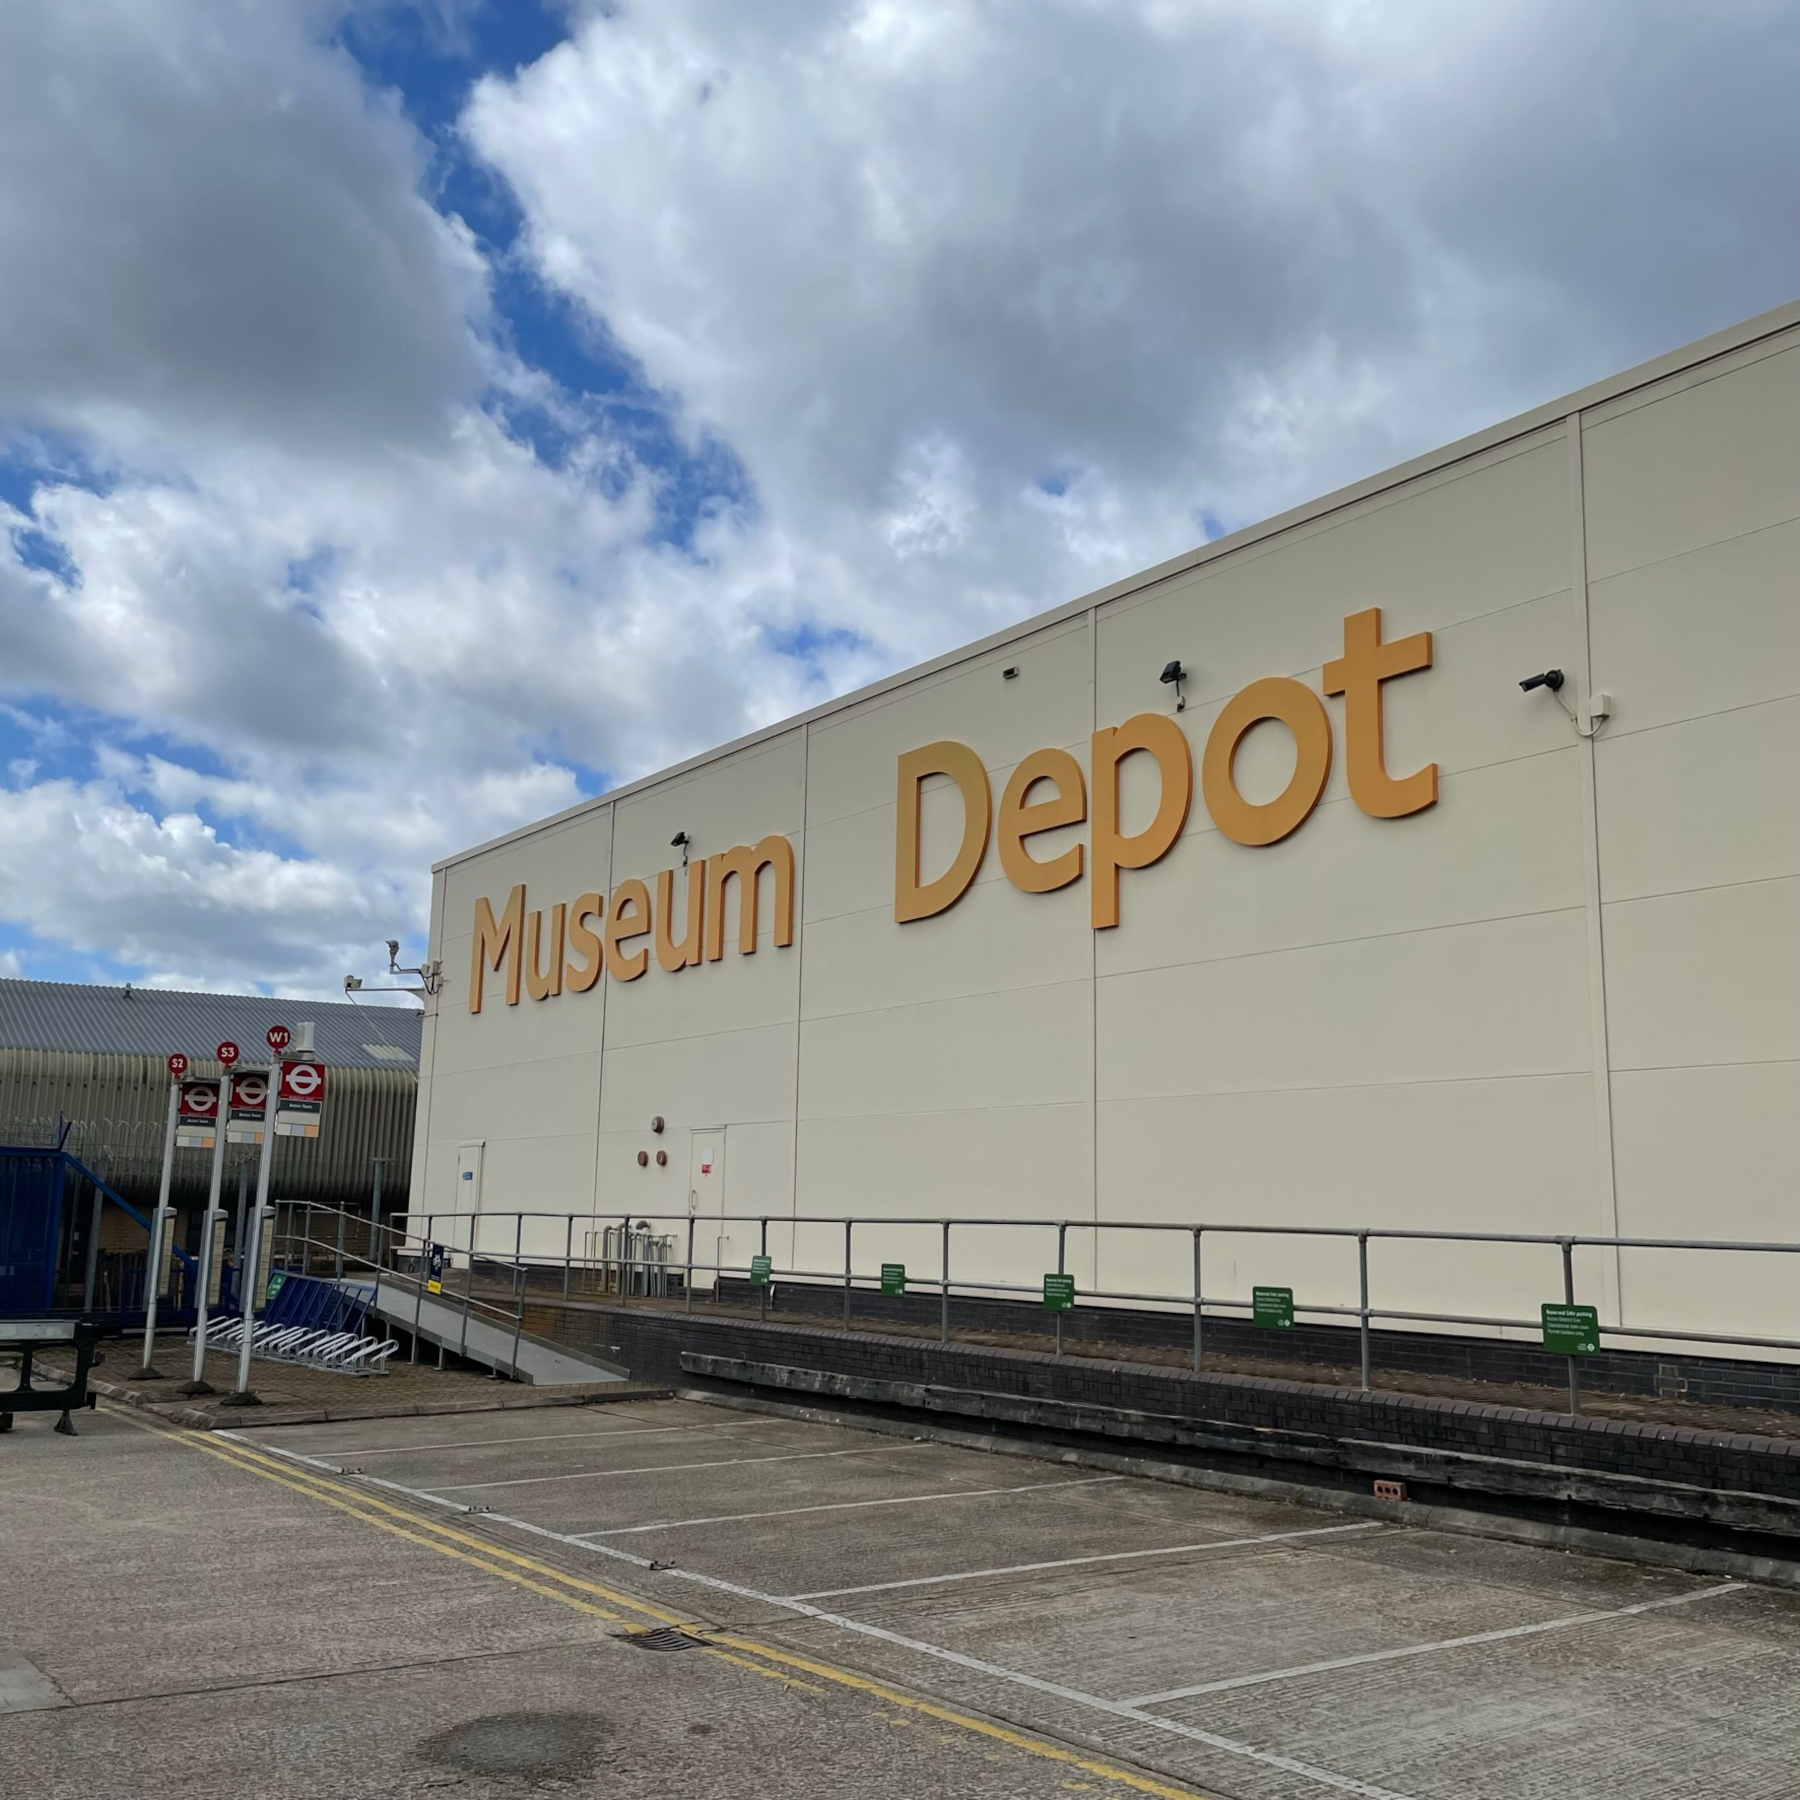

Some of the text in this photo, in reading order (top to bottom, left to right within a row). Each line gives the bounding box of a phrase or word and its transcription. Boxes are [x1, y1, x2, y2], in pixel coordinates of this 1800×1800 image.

[469, 607, 1438, 1014] Museum Depot
[269, 1032, 289, 1043] W1
[221, 1047, 235, 1058] S3
[171, 1058, 184, 1068] S2
